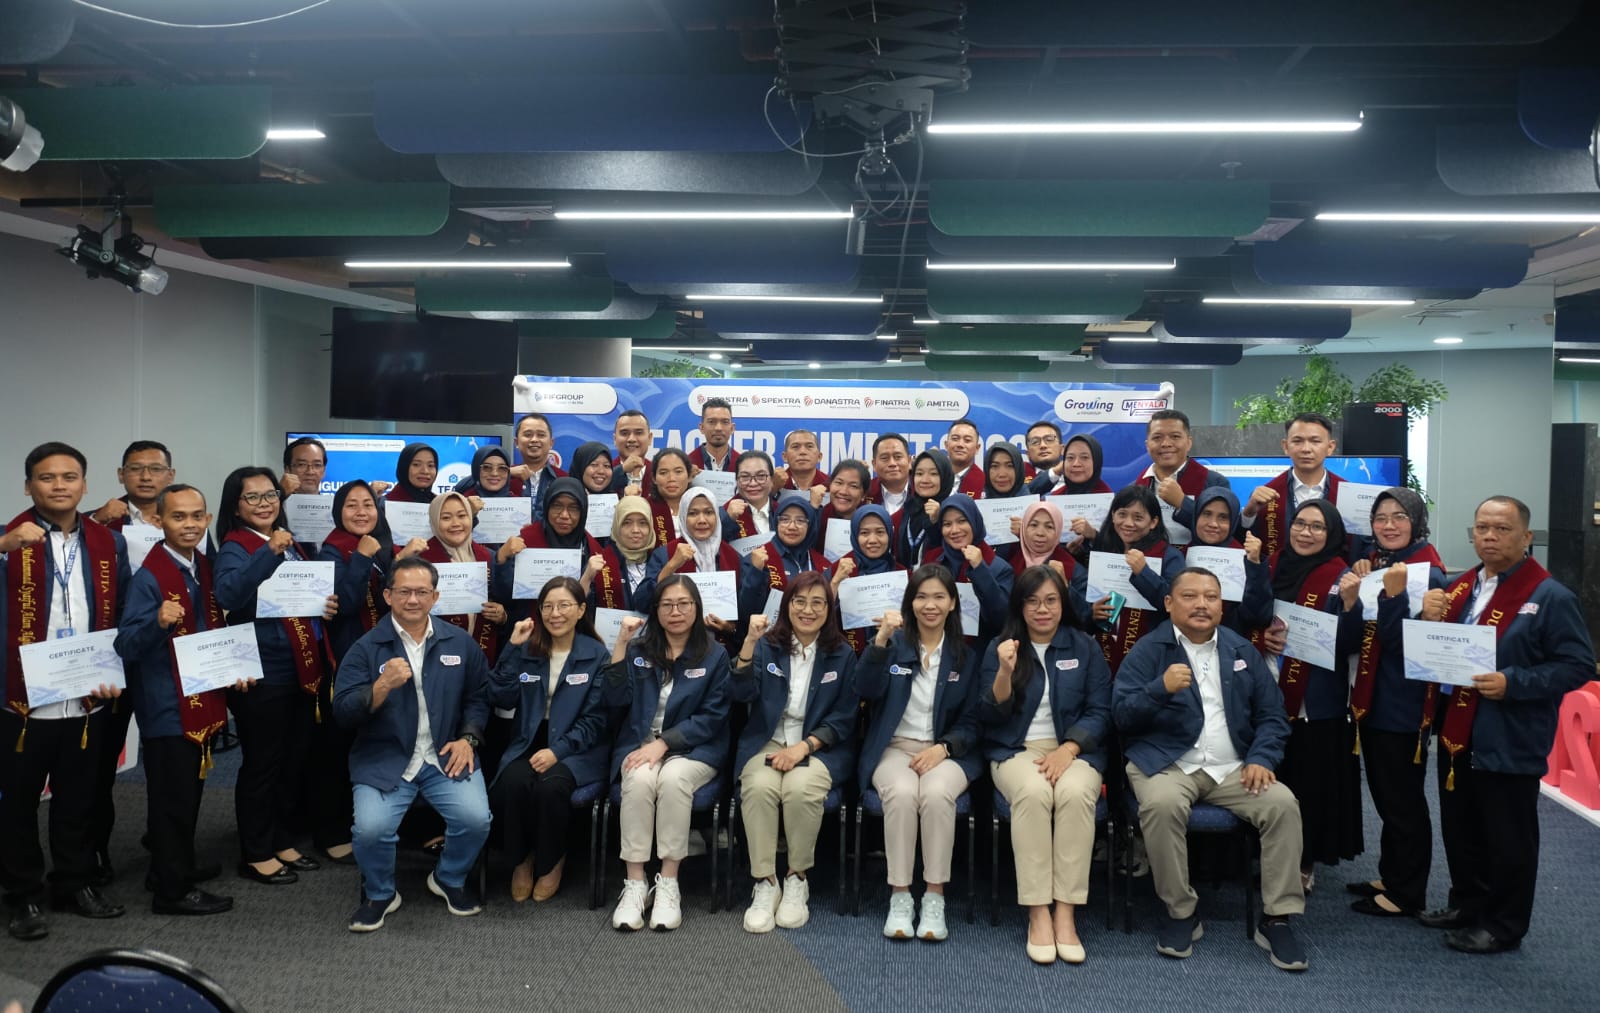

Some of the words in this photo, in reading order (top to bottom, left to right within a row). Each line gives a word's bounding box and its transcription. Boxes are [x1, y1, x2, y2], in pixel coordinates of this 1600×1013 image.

[814, 398, 861, 406] DANASTRA
[926, 400, 960, 408] AMITRA
[1064, 397, 1114, 413] Growing
[1125, 400, 1165, 409] MENYALA
[1426, 634, 1470, 644] CERTIFICATE
[196, 638, 235, 652] CERTIFICATE
[48, 645, 96, 660] CERTIFICATE
